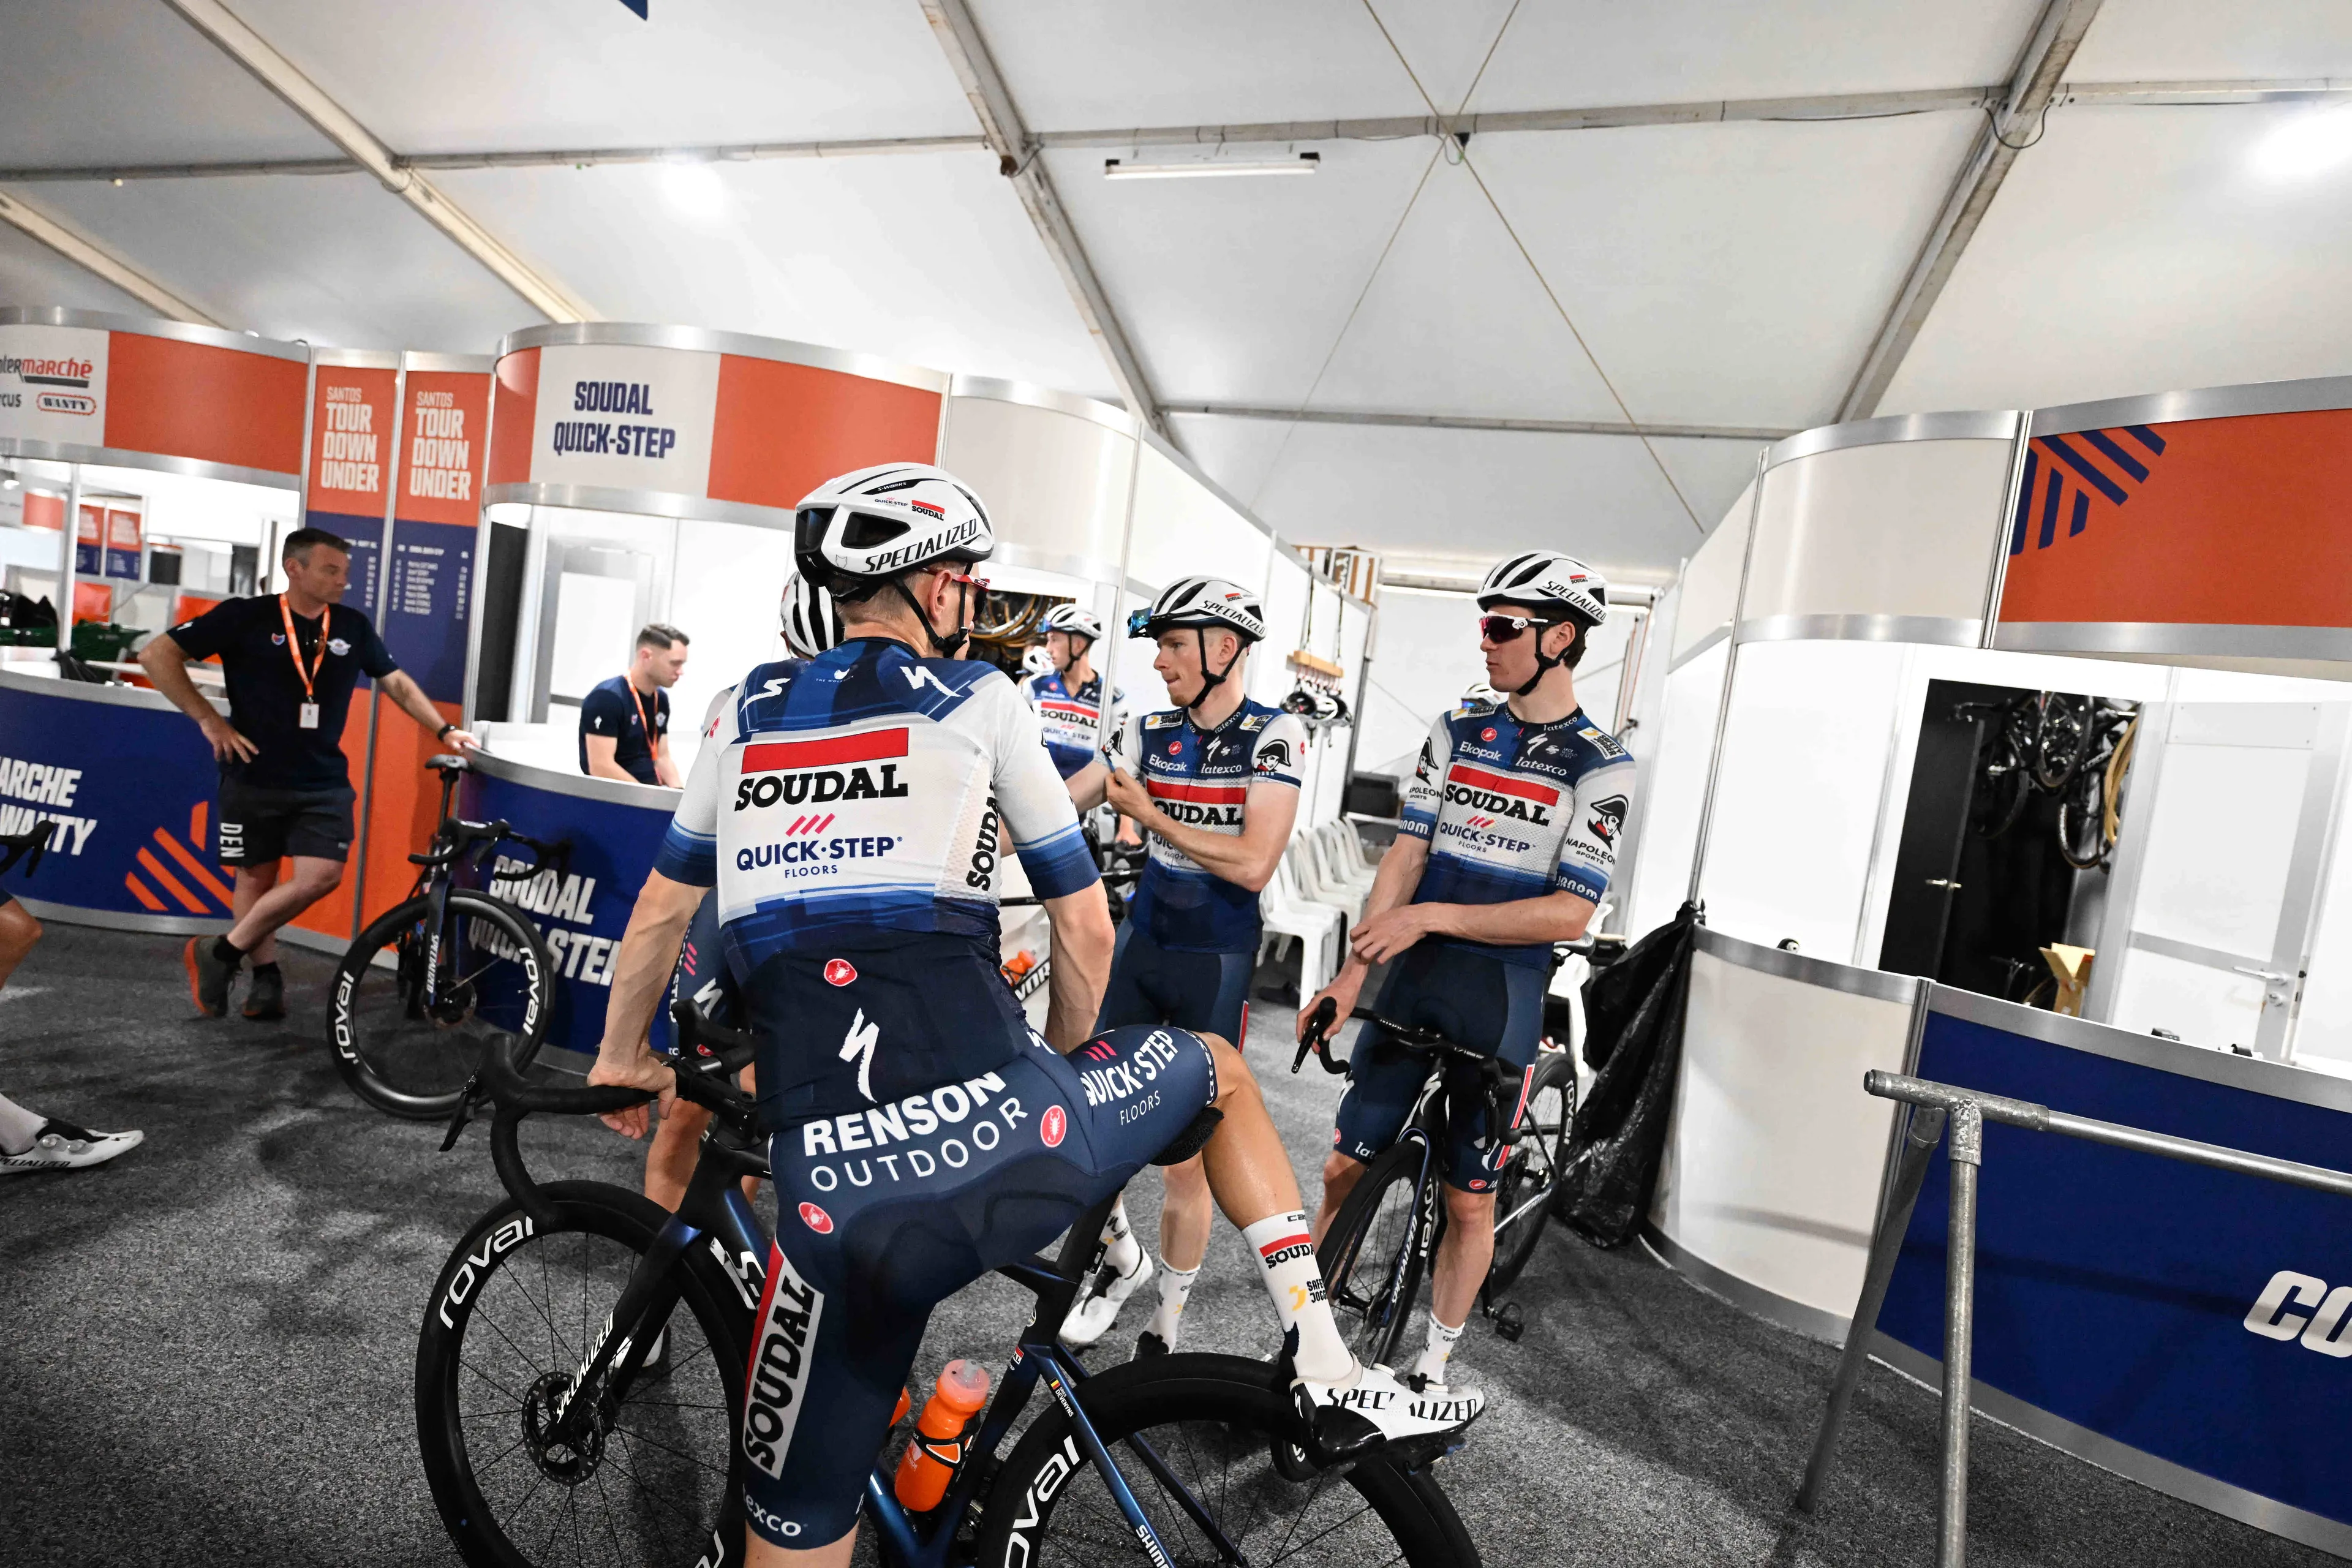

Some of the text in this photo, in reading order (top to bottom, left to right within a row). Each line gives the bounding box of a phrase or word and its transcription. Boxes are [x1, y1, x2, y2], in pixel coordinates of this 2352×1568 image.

[326, 386, 362, 402] SANTOS
[417, 391, 454, 407] SANTOS
[575, 381, 653, 415] SOUDAL
[326, 402, 372, 432] TOUR
[415, 407, 464, 439] TOUR
[323, 431, 377, 462] DOWN
[412, 437, 469, 469] DOWN
[554, 422, 676, 458] QUICK-STEP
[321, 461, 379, 492] UNDER
[410, 467, 471, 500] UNDER
[878, 481, 907, 491] S-WORKS
[911, 505, 944, 521] SOUDAL
[862, 518, 977, 573] SPECIALIZED
[1542, 581, 1607, 620] SPECIALIZED
[1199, 600, 1265, 635] SPECIALIZED
[1041, 710, 1098, 729] SOUDAL
[1544, 717, 1577, 731] latexco
[1149, 753, 1186, 772] Ekopak
[1460, 741, 1502, 761] Ekopak
[1516, 756, 1567, 776] latexco
[0, 756, 83, 808] ARCHE
[1200, 763, 1242, 774] latexco
[734, 764, 908, 812] SOUDAL
[1445, 783, 1550, 827] SOUDAL
[220, 823, 245, 857] DEN
[966, 780, 998, 891] SOUDA
[1458, 840, 1487, 853] FLOORS
[785, 865, 838, 879] FLOORS
[1576, 850, 1604, 865] SPORTS
[489, 855, 596, 925] SOUDAL
[519, 947, 540, 1036] roval
[335, 971, 356, 1060] roval
[803, 1071, 1006, 1156] RENSON
[1120, 1090, 1161, 1126] FLOORS
[811, 1097, 1028, 1191] OUTDOOR
[1420, 1178, 1433, 1257] oval
[439, 1216, 533, 1329] roval
[557, 1312, 613, 1423] SPECIALIZED
[745, 1275, 815, 1471] SOUDAL
[1055, 1389, 1074, 1417] DEVENYNS
